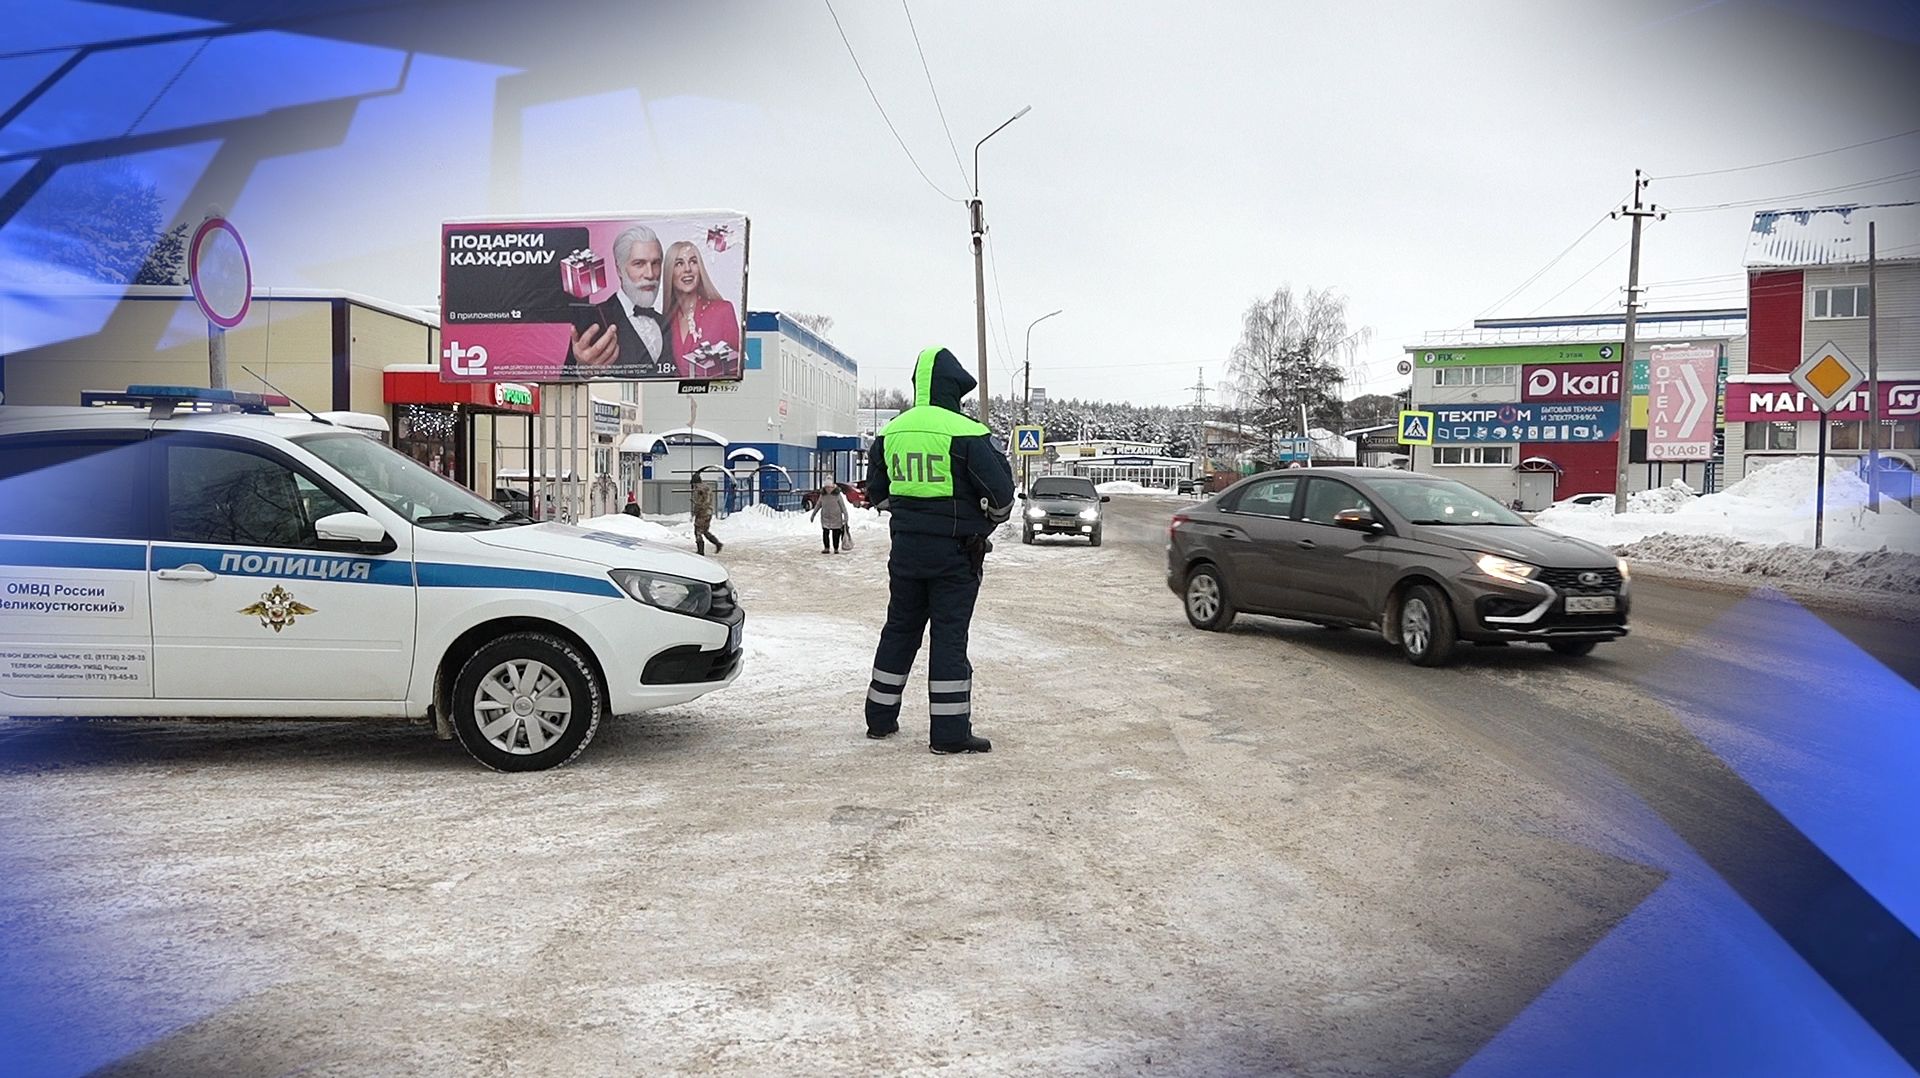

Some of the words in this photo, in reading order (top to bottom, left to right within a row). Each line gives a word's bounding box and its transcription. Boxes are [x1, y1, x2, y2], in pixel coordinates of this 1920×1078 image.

[450, 233, 544, 251] ПОДАРКИ
[450, 250, 556, 267] КАЖДОМУ
[457, 313, 510, 321] приложении
[511, 310, 522, 319] t2
[443, 341, 488, 376] t2
[1438, 353, 1453, 361] FIX
[657, 363, 677, 374] 18+
[1562, 370, 1619, 395] kari
[1573, 405, 1604, 413] ТЕХНИКА
[1655, 366, 1669, 438] ОТЕЛЬ
[1750, 391, 1870, 413] МАГИТ
[1668, 446, 1706, 456] КАФЕ
[892, 452, 946, 482] ДПС
[220, 553, 371, 580] ПОЛИЦИЯ
[7, 583, 50, 597] ОМВД
[54, 584, 105, 597] России
